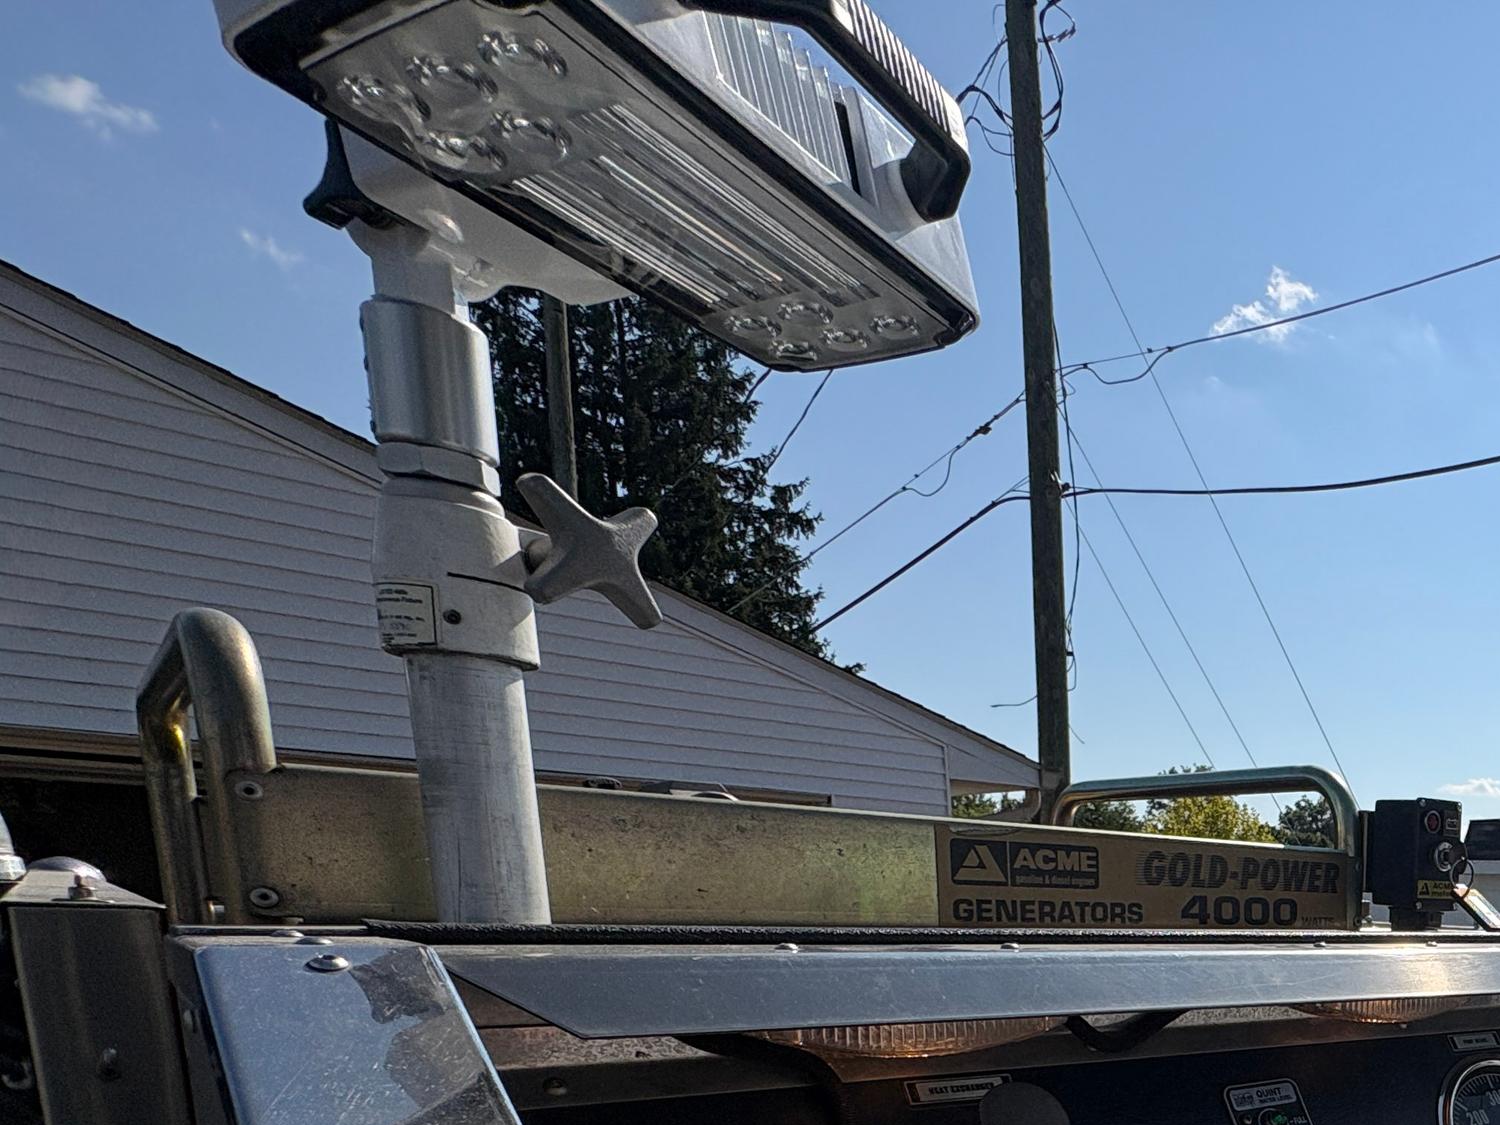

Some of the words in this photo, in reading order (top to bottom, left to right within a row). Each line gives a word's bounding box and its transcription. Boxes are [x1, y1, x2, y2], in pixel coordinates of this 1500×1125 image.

[1012, 848, 1097, 872] ACME
[1141, 850, 1340, 893] GOLD-POWER
[952, 898, 1144, 925] GENERATORS
[1181, 895, 1298, 926] 4000
[1255, 1087, 1282, 1099] QUINT
